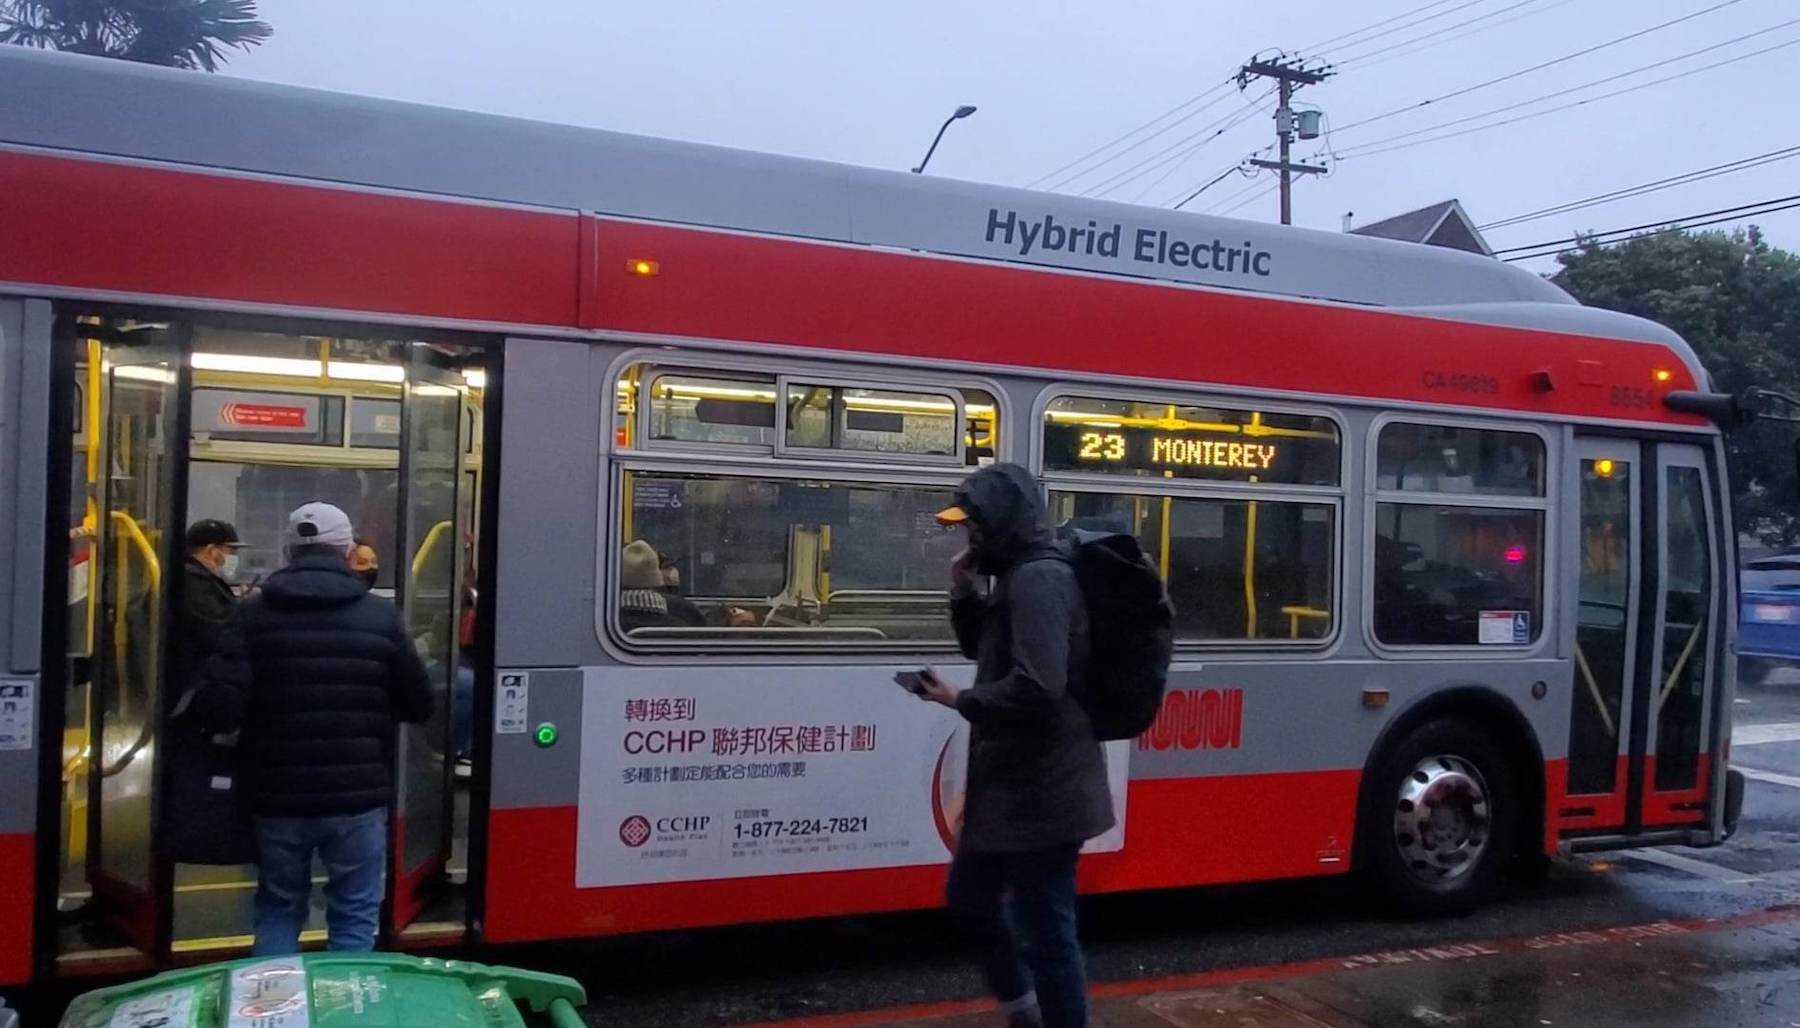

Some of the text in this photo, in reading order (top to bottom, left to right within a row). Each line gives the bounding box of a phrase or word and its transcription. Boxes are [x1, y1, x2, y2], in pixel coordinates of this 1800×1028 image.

[985, 208, 1272, 277] Hybrid Electric
[1078, 433, 1276, 469] 23 MONTEREY
[624, 698, 696, 722] 轉換到
[623, 723, 877, 756] CCHP 聯邦保健計劃
[656, 816, 711, 833] CCHP
[733, 816, 870, 839] 1-877-224-7821
